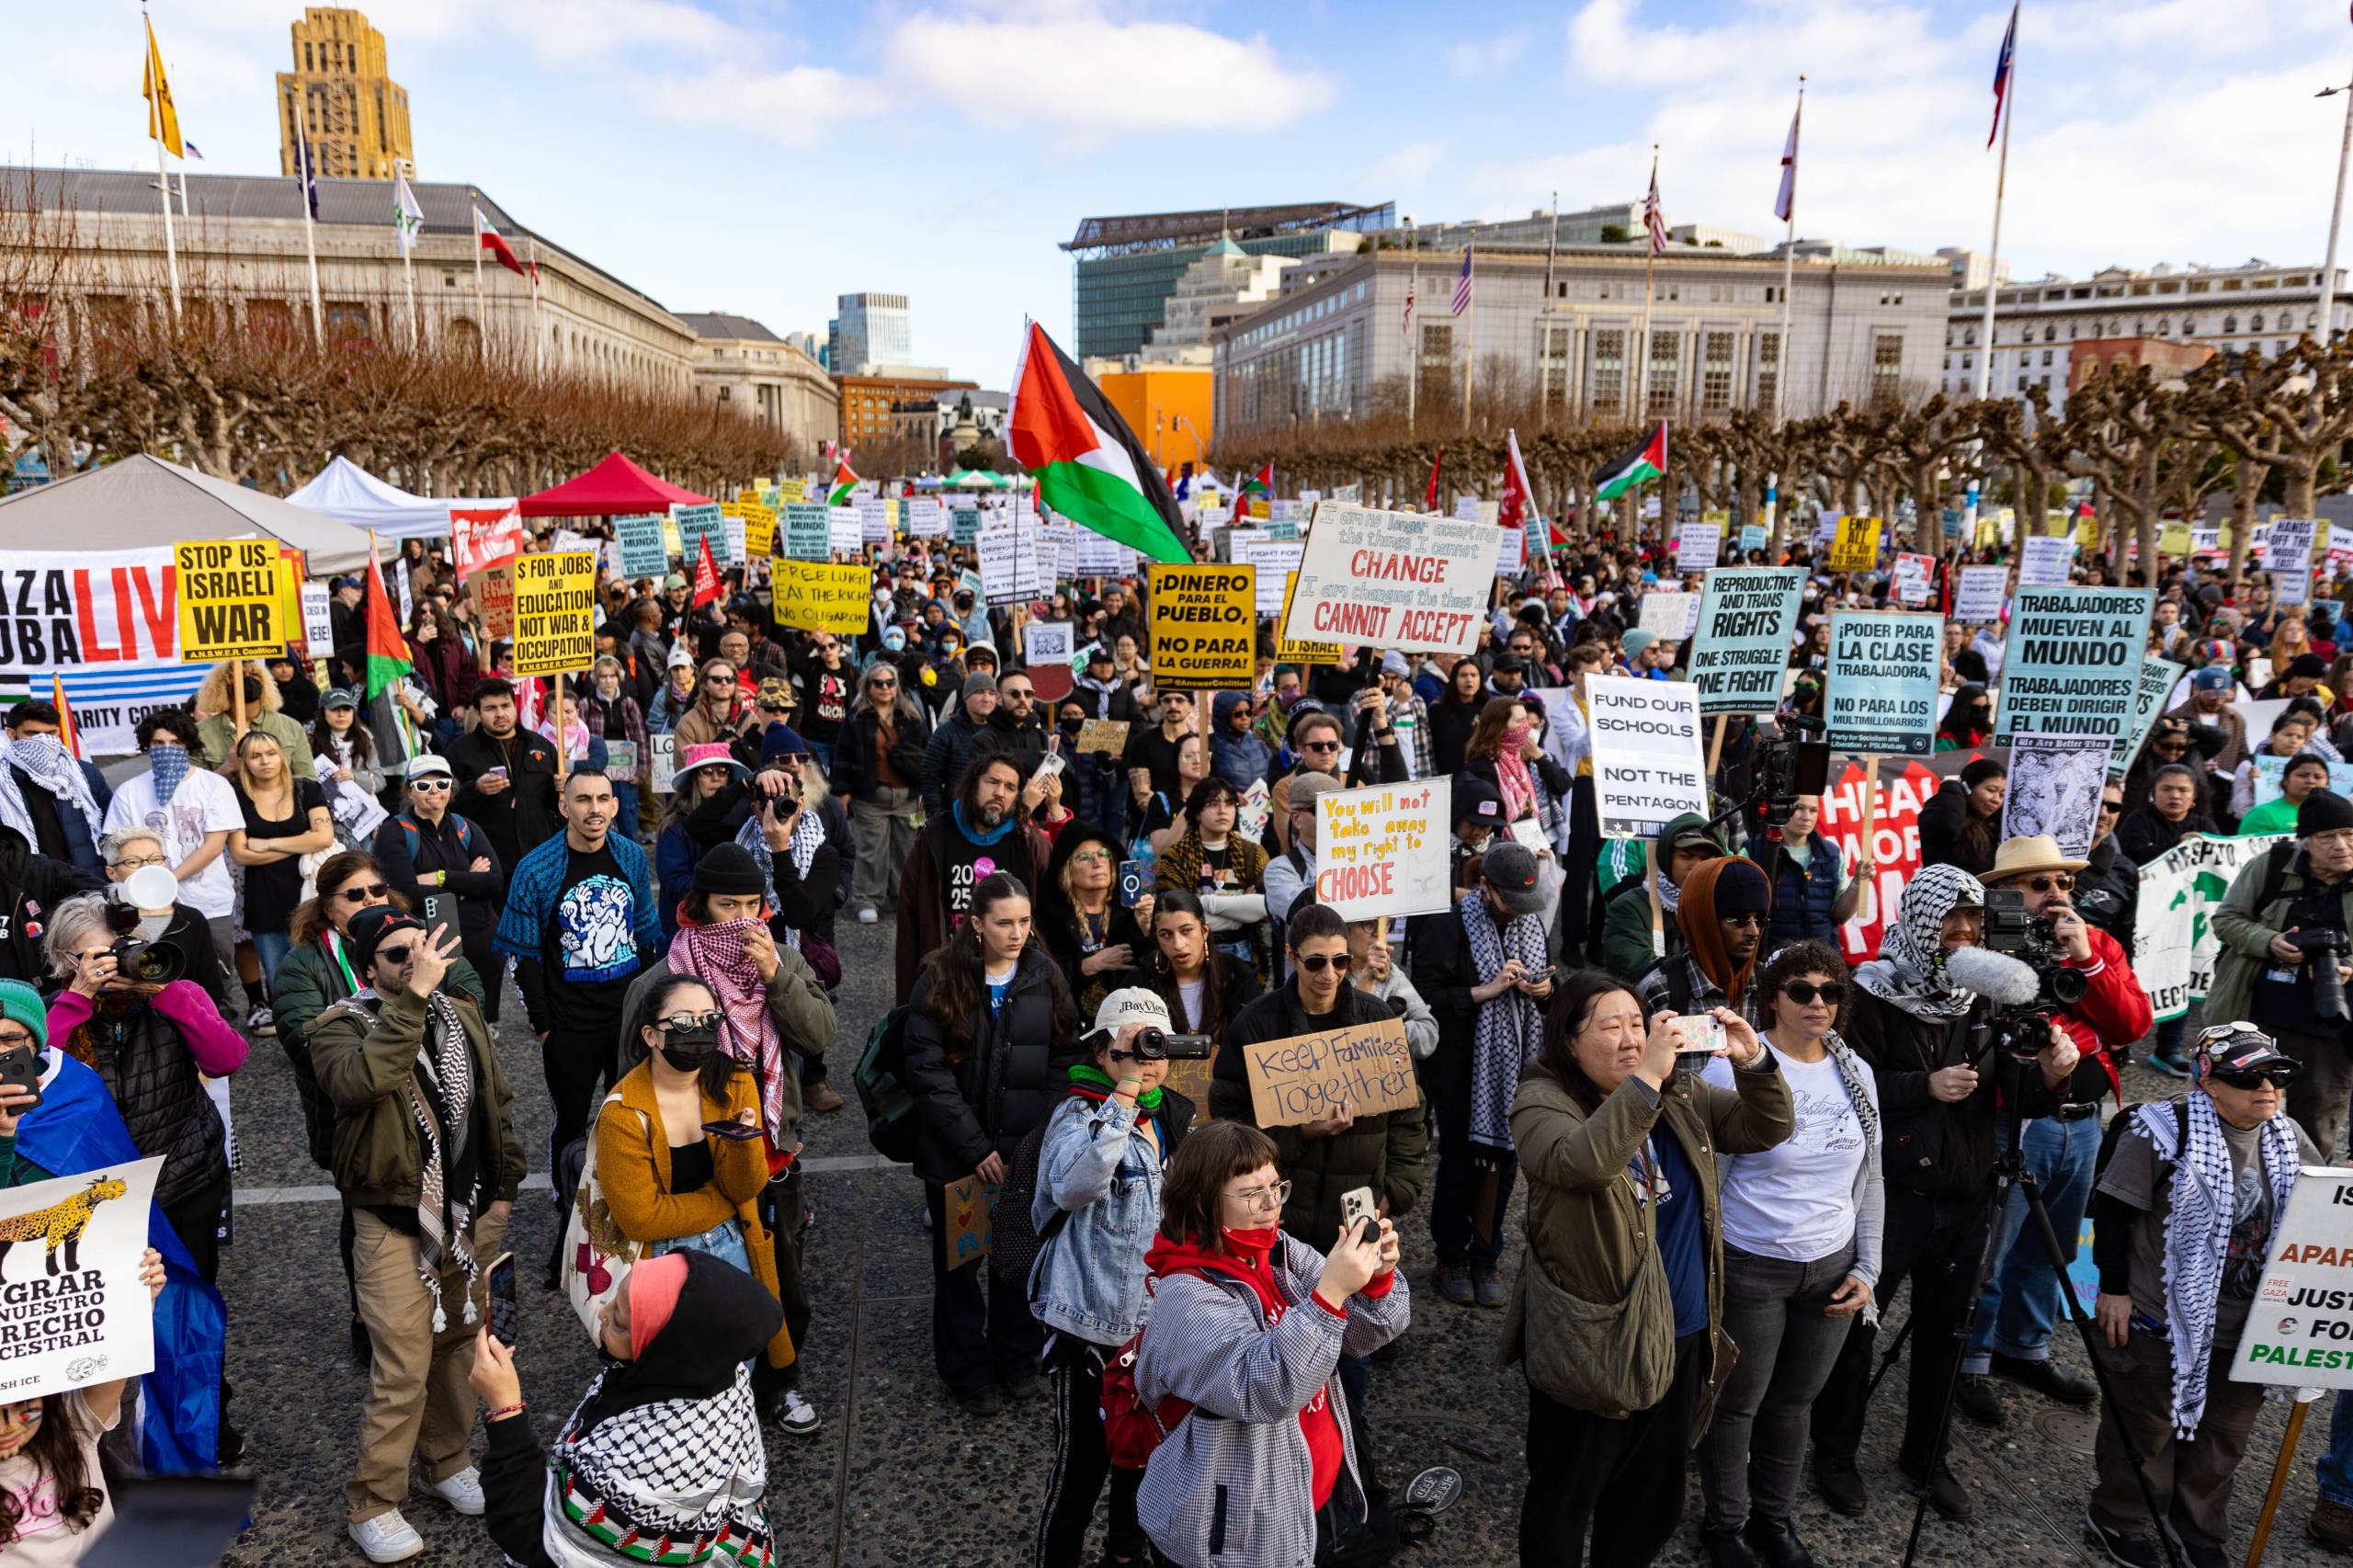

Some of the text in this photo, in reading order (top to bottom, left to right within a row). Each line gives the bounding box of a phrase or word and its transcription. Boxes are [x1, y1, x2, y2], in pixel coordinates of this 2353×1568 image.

[684, 522, 720, 535] MUNDO
[790, 521, 825, 530] MUNDO
[1319, 505, 1500, 544] I am no longer accepting
[1848, 517, 1871, 531] END
[2276, 521, 2313, 533] HANDS
[623, 536, 659, 548] MUNDO
[1338, 528, 1481, 559] the things I cannot
[1847, 530, 1866, 544] ALL
[2270, 534, 2312, 548] OFF THE
[180, 544, 232, 570] STOP
[1350, 549, 1449, 584] CHANGE
[1833, 554, 1844, 564] TO
[2275, 559, 2296, 568] EAST
[517, 555, 593, 581] $ FOR JOBS
[778, 562, 867, 585] FREE LUIGI
[187, 569, 275, 599] ISRAELI
[549, 579, 563, 591] AND
[776, 582, 835, 602] EAT THE
[1154, 574, 1249, 595] ¡DINERO
[1301, 575, 1318, 597] I
[1321, 583, 1348, 598] am
[1351, 581, 1414, 606] changing
[1416, 585, 1438, 606] the
[1473, 590, 1490, 609] I
[1712, 575, 1799, 593] REPRODUCTIVE
[517, 589, 593, 615] EDUCATION
[1177, 593, 1228, 604] PARA EL
[1719, 592, 1784, 609] AND TRANS
[2019, 595, 2146, 615] TRABAJADORES
[192, 603, 271, 645] WAR
[777, 605, 868, 624] NO OLIGARCHY
[1156, 605, 1248, 625] PUEBLO,
[1313, 600, 1474, 645] CANNOT ACCEPT
[1711, 610, 1782, 638] RIGHTS
[519, 613, 590, 638] NOT WAR &
[1838, 623, 1936, 640] ¡PODER PARA
[2019, 618, 2135, 638] MUEVEN AL
[242, 646, 278, 656] Coalition
[517, 634, 593, 661] OCCUPATION
[1157, 636, 1249, 653] NO PARA
[1298, 640, 1340, 653] ISRAEL
[1837, 641, 1934, 663] LA CLASE
[2021, 639, 2128, 666] MUNDO
[562, 658, 590, 669] Coalition
[1157, 656, 1248, 669] LA GUERRA!
[1695, 649, 1783, 668] ONE STRUGGLE
[1174, 678, 1251, 687] @AnswerCoalition
[1692, 670, 1779, 695] ONE FIGHT
[1836, 663, 1933, 682] TRABAJADORA,
[2007, 676, 2132, 696] TRABAJADORES
[1595, 693, 1694, 713] FUND OUR
[1834, 697, 1929, 715] NO PARA LOS
[2007, 696, 2128, 714] DEBEN DIRIGIR
[1597, 718, 1694, 738] SCHOOLS
[1832, 715, 1928, 729] MULTIMILLONARIOS!
[2009, 714, 2120, 734] EL MUNDO
[1830, 740, 1862, 748] Liberation
[2036, 738, 2053, 746] Are
[2055, 739, 2083, 747] Better
[2084, 740, 2107, 748] Than
[1604, 767, 1698, 788] NOT THE
[1324, 789, 1432, 818] You will not
[1604, 794, 1701, 812] PENTAGON
[1329, 814, 1427, 841] take away
[1331, 832, 1422, 863] my right to
[951, 864, 974, 885] 20
[1316, 861, 1395, 903] CHOOSE
[950, 887, 972, 910] 25
[1266, 1064, 1415, 1119] Together
[2261, 1288, 2289, 1298] GAZA
[2267, 1278, 2291, 1288] FREE
[0, 1290, 106, 1323] NUESTRO
[1, 1308, 106, 1345] RECHO
[20, 1375, 41, 1387] ICE
